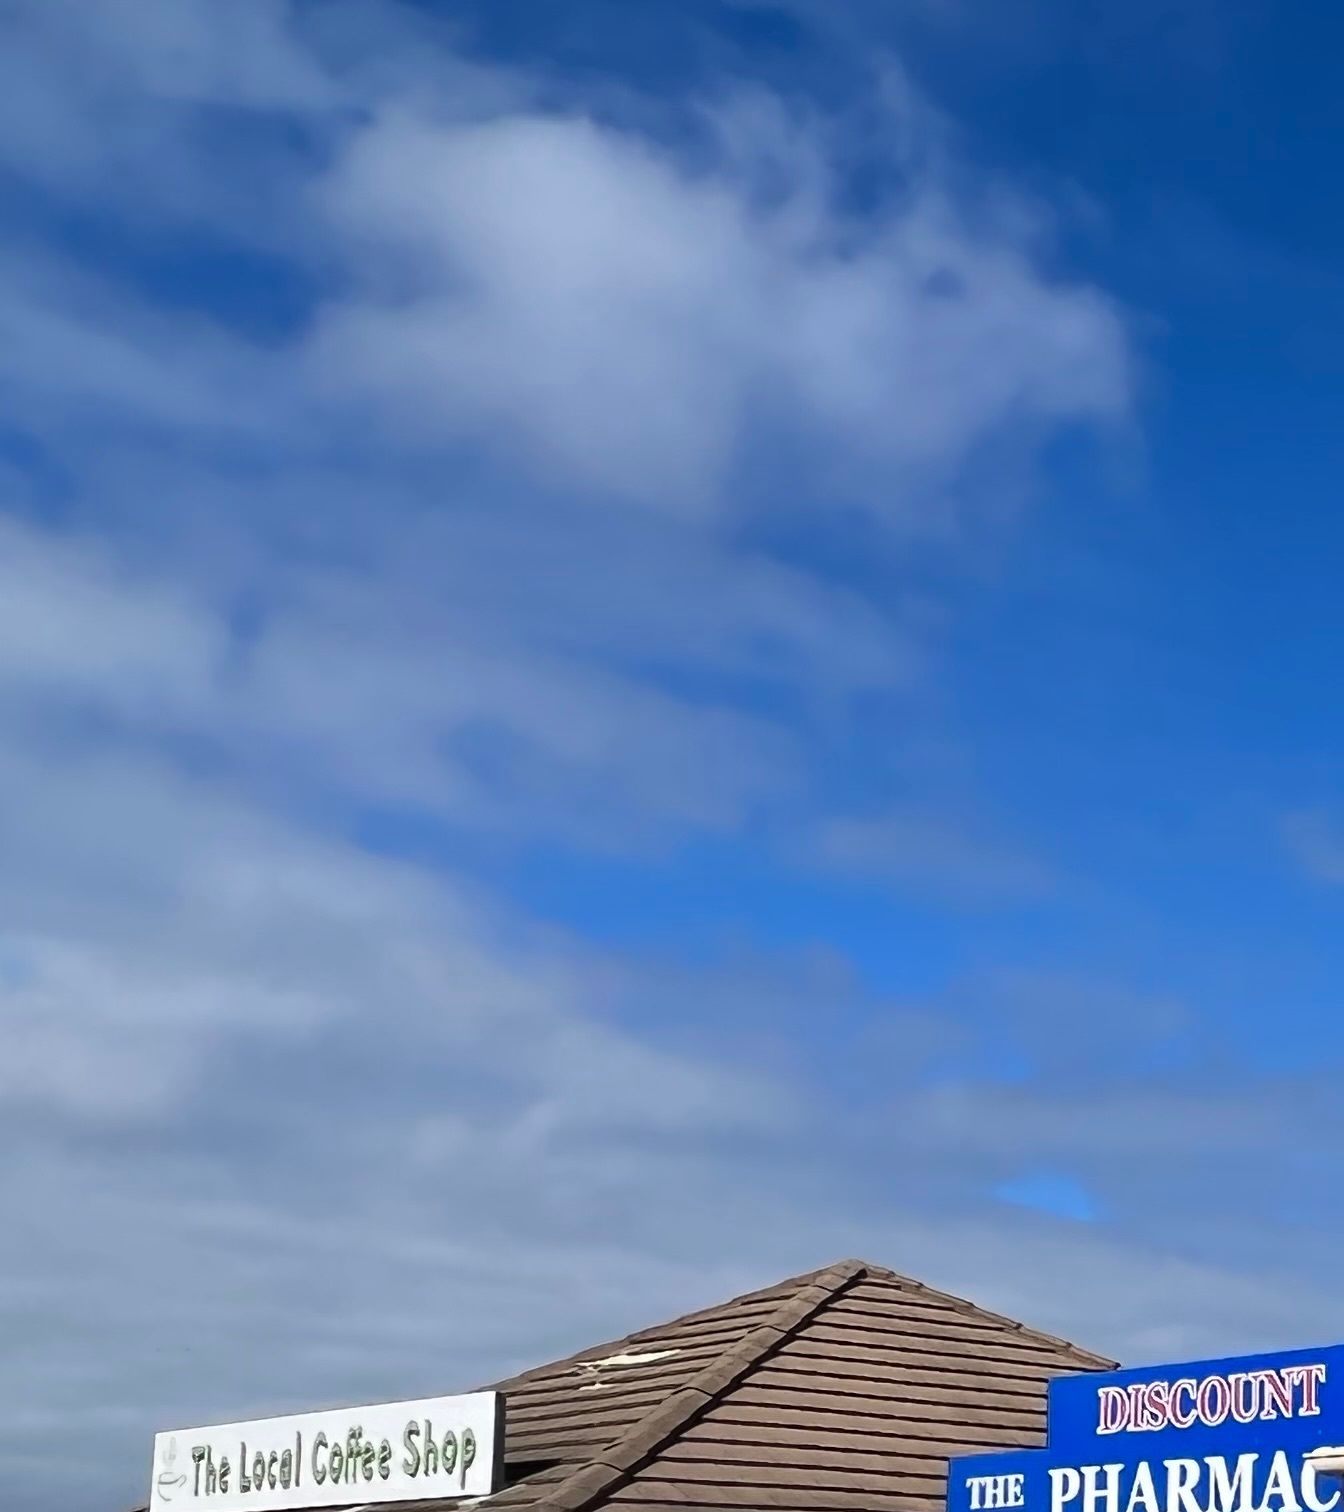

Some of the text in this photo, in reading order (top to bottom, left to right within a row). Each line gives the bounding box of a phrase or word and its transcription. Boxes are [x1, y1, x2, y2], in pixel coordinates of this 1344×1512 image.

[1096, 1364, 1327, 1436] DISCOUNT
[191, 1418, 477, 1497] The Local Coffee Shop
[965, 1473, 1025, 1511] THE
